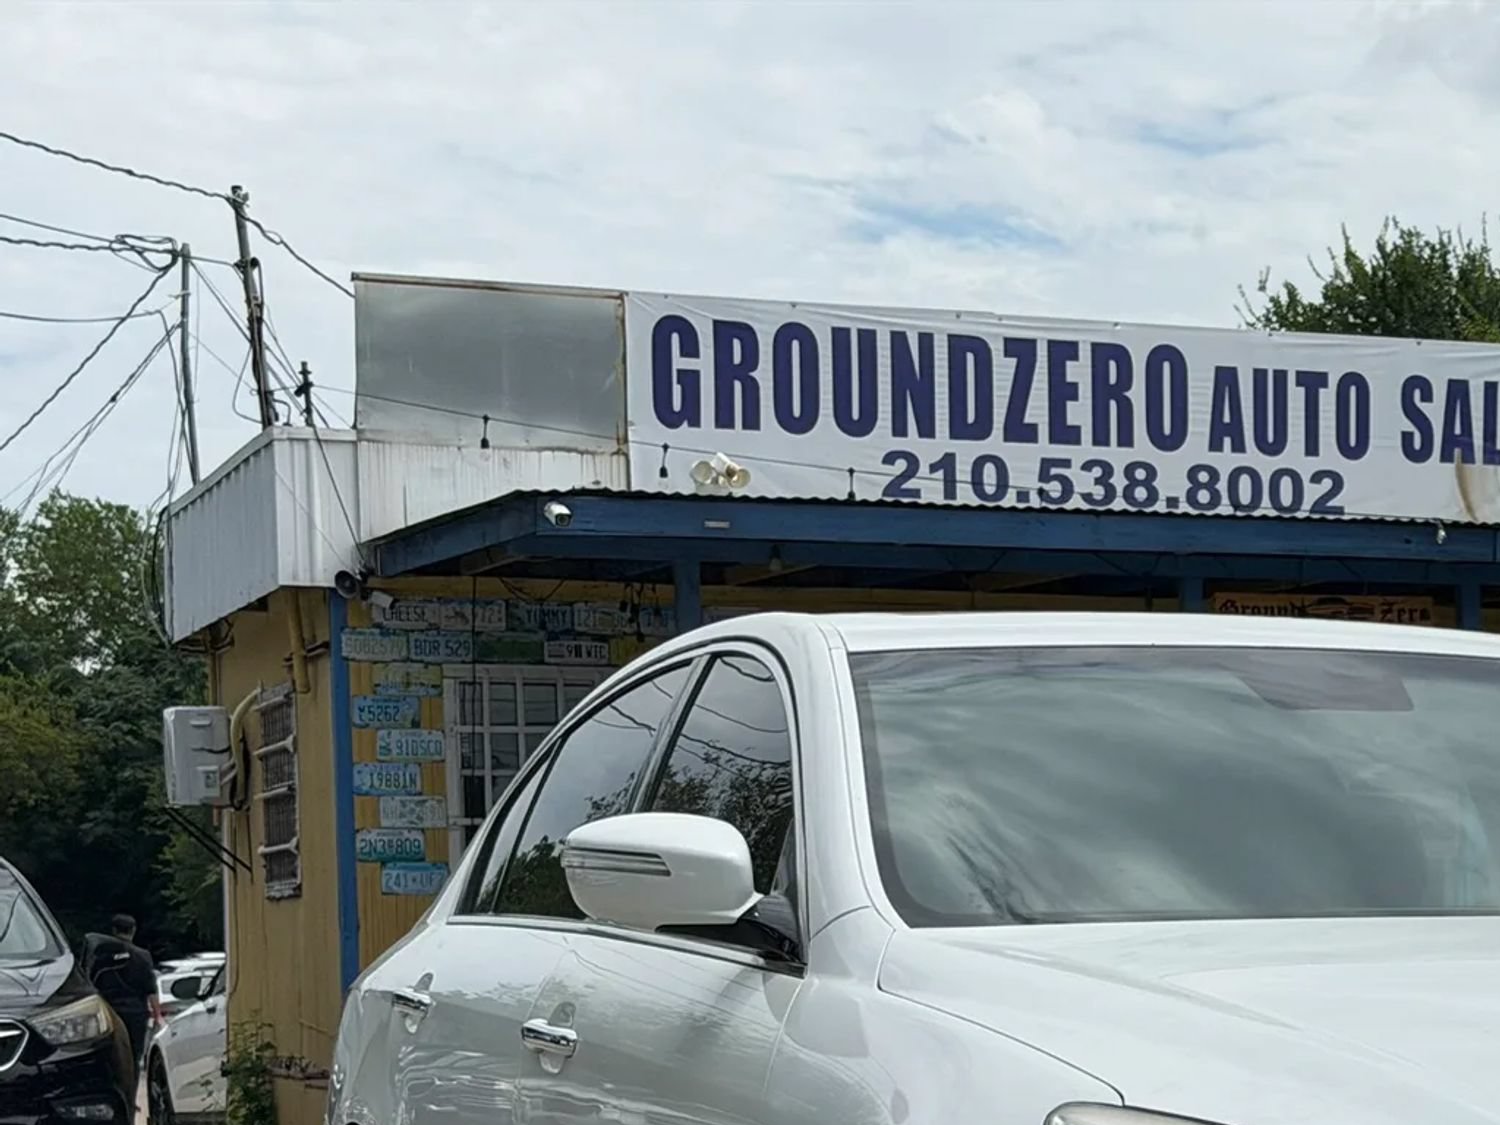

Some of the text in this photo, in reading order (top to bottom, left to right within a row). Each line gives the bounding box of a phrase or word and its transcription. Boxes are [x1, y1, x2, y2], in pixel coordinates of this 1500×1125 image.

[650, 313, 1190, 453] GROUNDZERO
[1208, 366, 1371, 461] AUTO
[881, 449, 1346, 516] 210.538.8002
